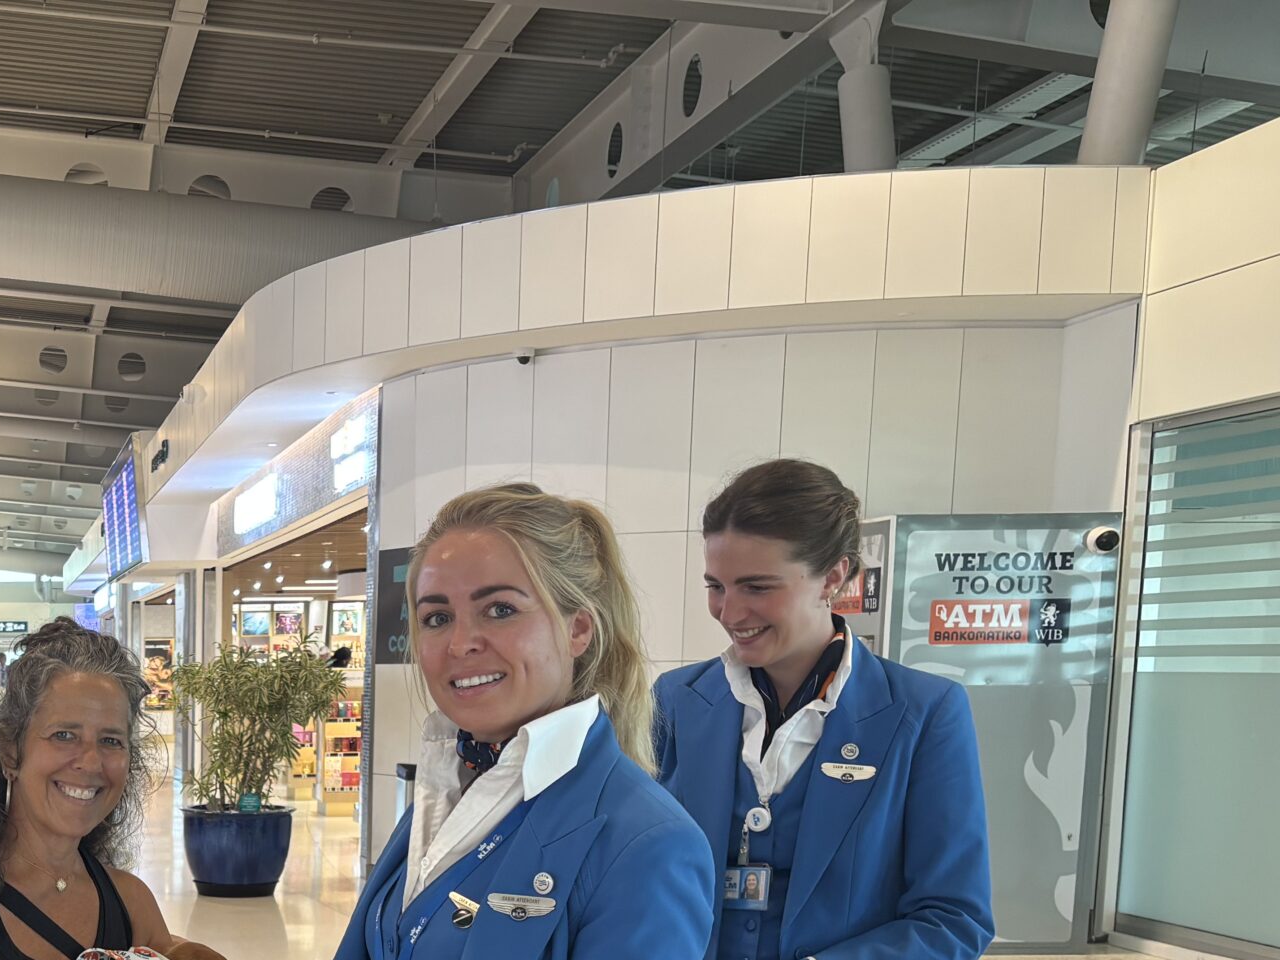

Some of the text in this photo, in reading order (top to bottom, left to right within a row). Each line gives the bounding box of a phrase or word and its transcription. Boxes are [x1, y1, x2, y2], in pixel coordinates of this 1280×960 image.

[935, 552, 1075, 572] WELCOME
[953, 575, 1053, 594] TO OUR
[864, 598, 877, 610] WIB
[945, 603, 1023, 628] ATM
[934, 630, 1022, 641] BANKOMATIKO
[1035, 629, 1063, 641] WIB
[477, 841, 496, 860] KLM
